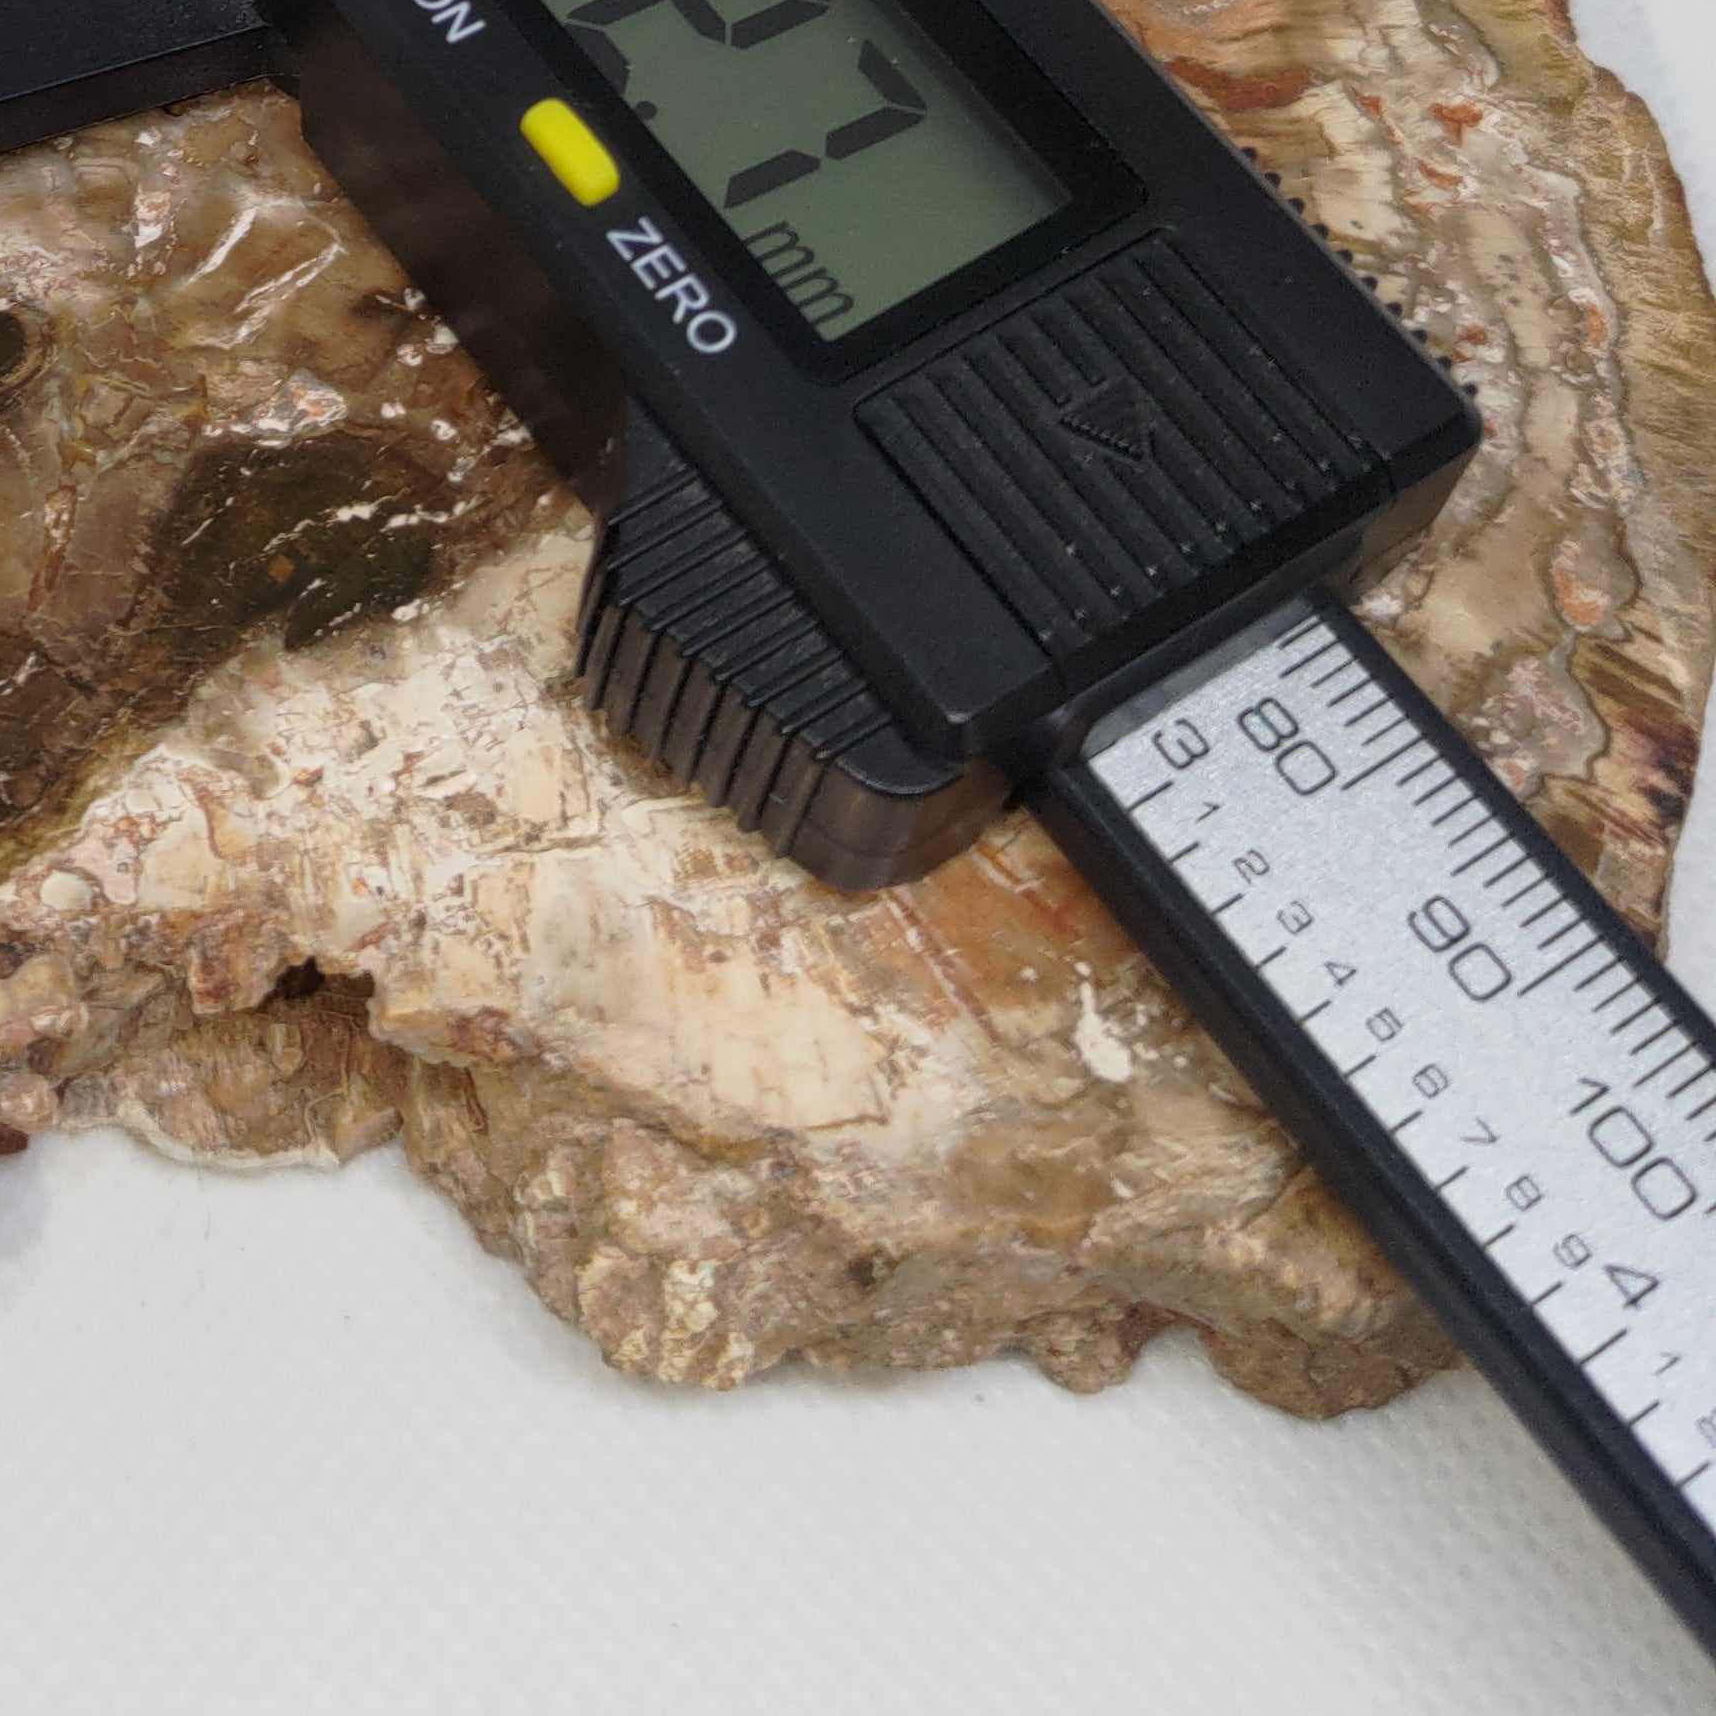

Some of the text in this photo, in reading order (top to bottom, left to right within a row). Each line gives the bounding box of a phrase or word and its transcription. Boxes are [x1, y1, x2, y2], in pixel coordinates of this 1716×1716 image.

[606, 216, 738, 355] ZERO
[742, 219, 855, 327] mm
[1151, 718, 1683, 1376] 3 1 2 3 4 5 6 7 8 9 4 1
[1235, 696, 1699, 1222] 80 90 100
